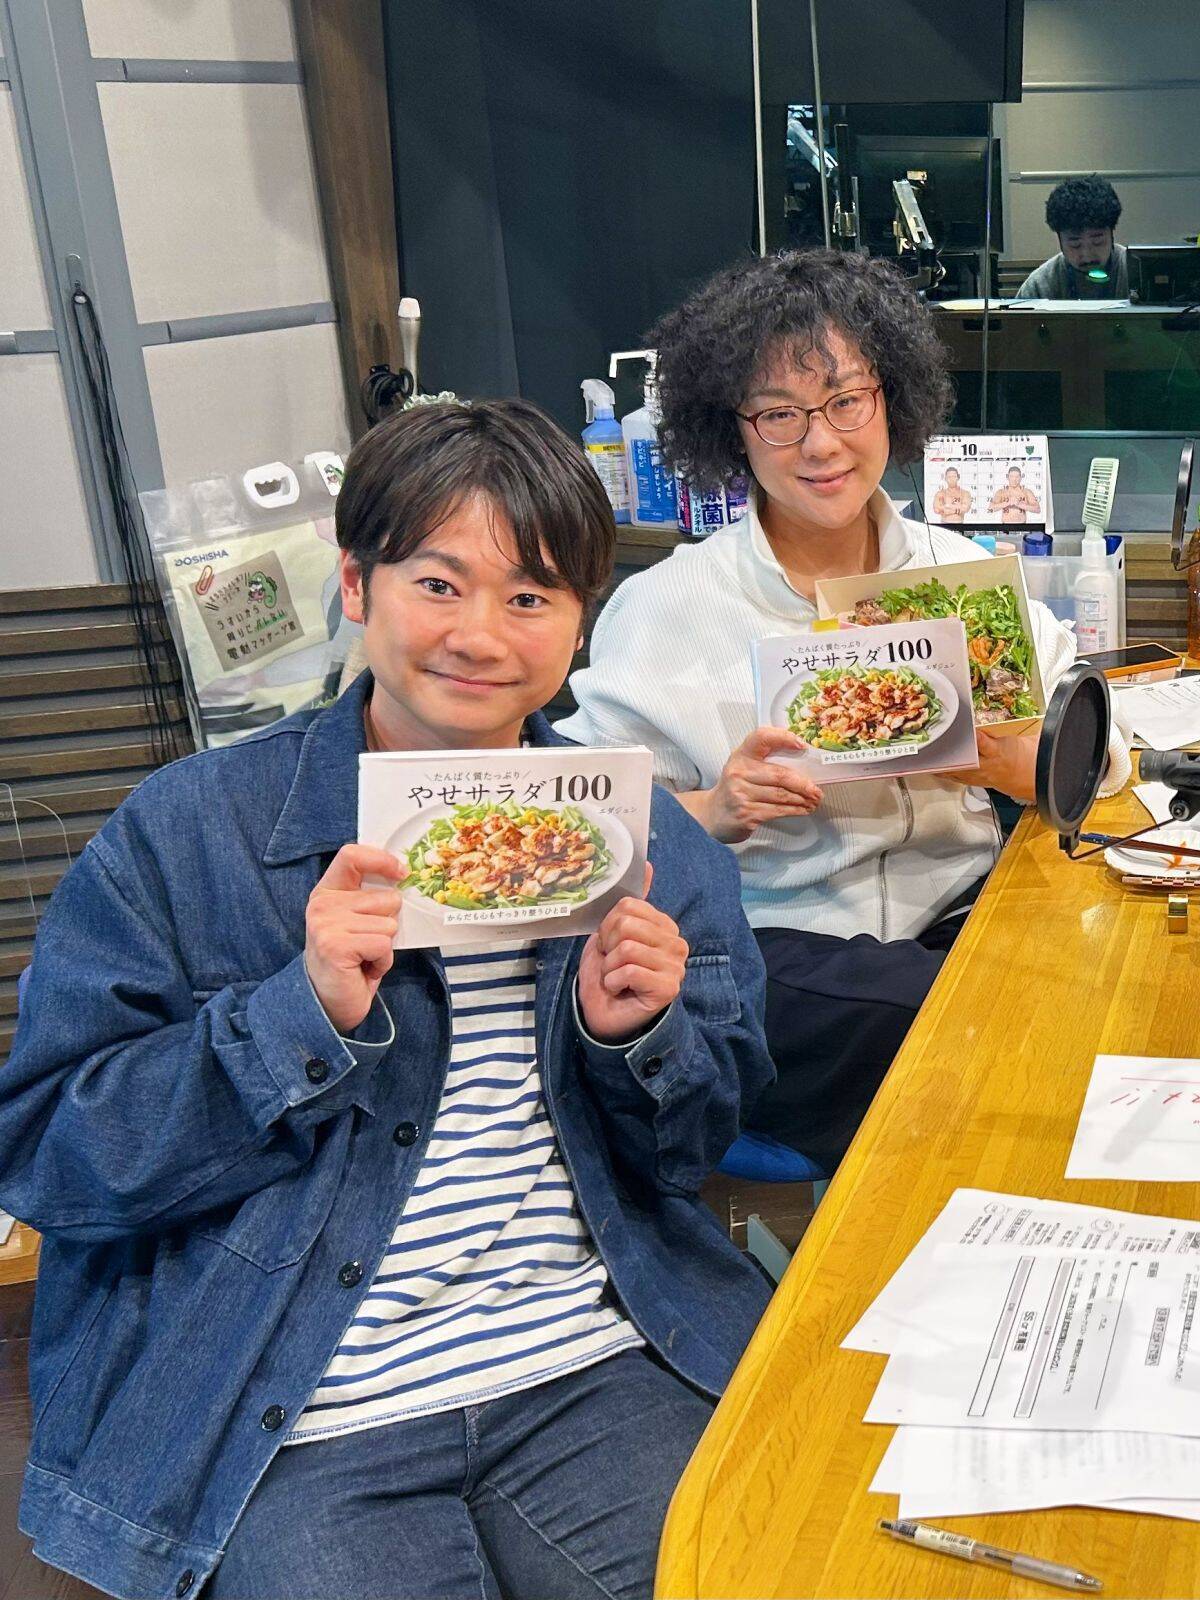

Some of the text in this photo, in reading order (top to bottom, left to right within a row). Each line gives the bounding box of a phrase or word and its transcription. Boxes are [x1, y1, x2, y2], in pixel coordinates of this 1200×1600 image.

[961, 443, 978, 456] 10
[797, 640, 862, 653] たんぱく質たっぷり
[433, 770, 521, 782] たんぱく質たっぷり
[446, 906, 569, 922] からだも心もすっきり整うひと皿
